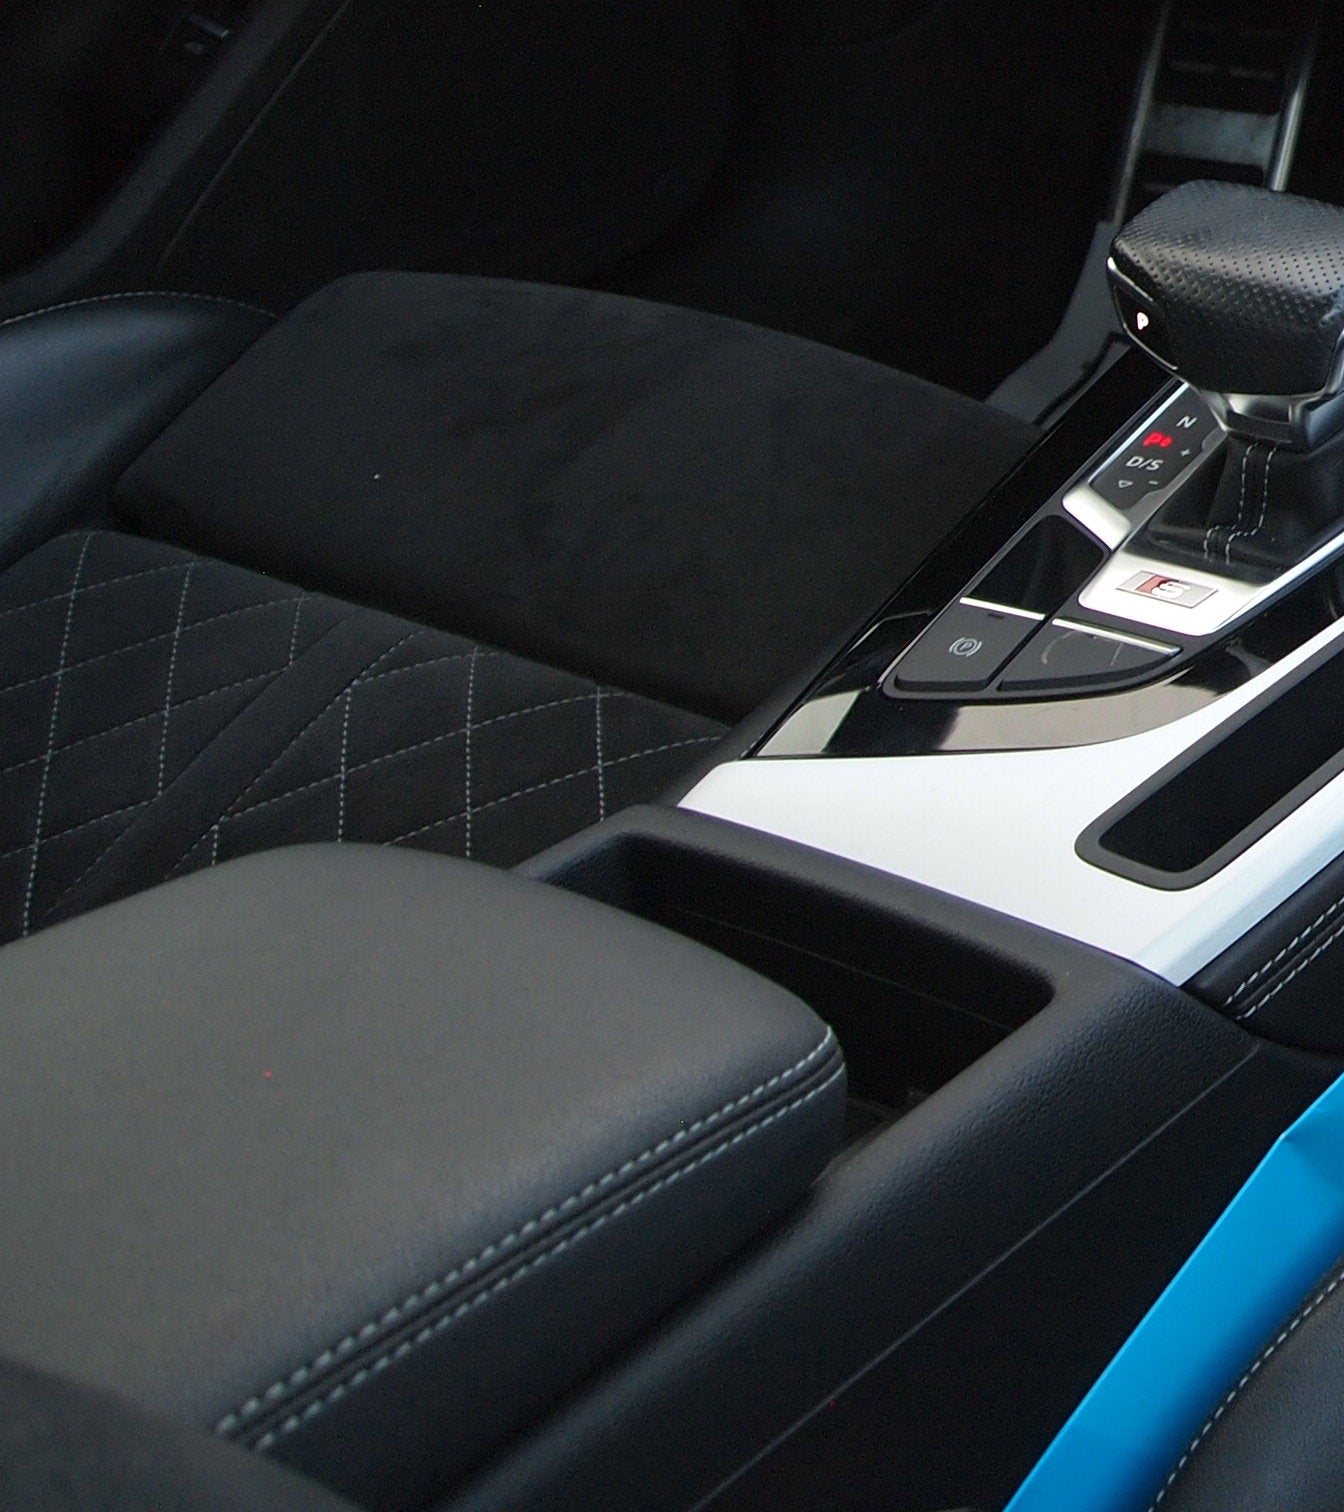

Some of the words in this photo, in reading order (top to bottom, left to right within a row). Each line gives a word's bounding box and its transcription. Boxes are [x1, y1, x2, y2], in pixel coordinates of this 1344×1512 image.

[1136, 311, 1150, 331] P
[1176, 415, 1198, 429] N
[1126, 455, 1164, 471] D/S
